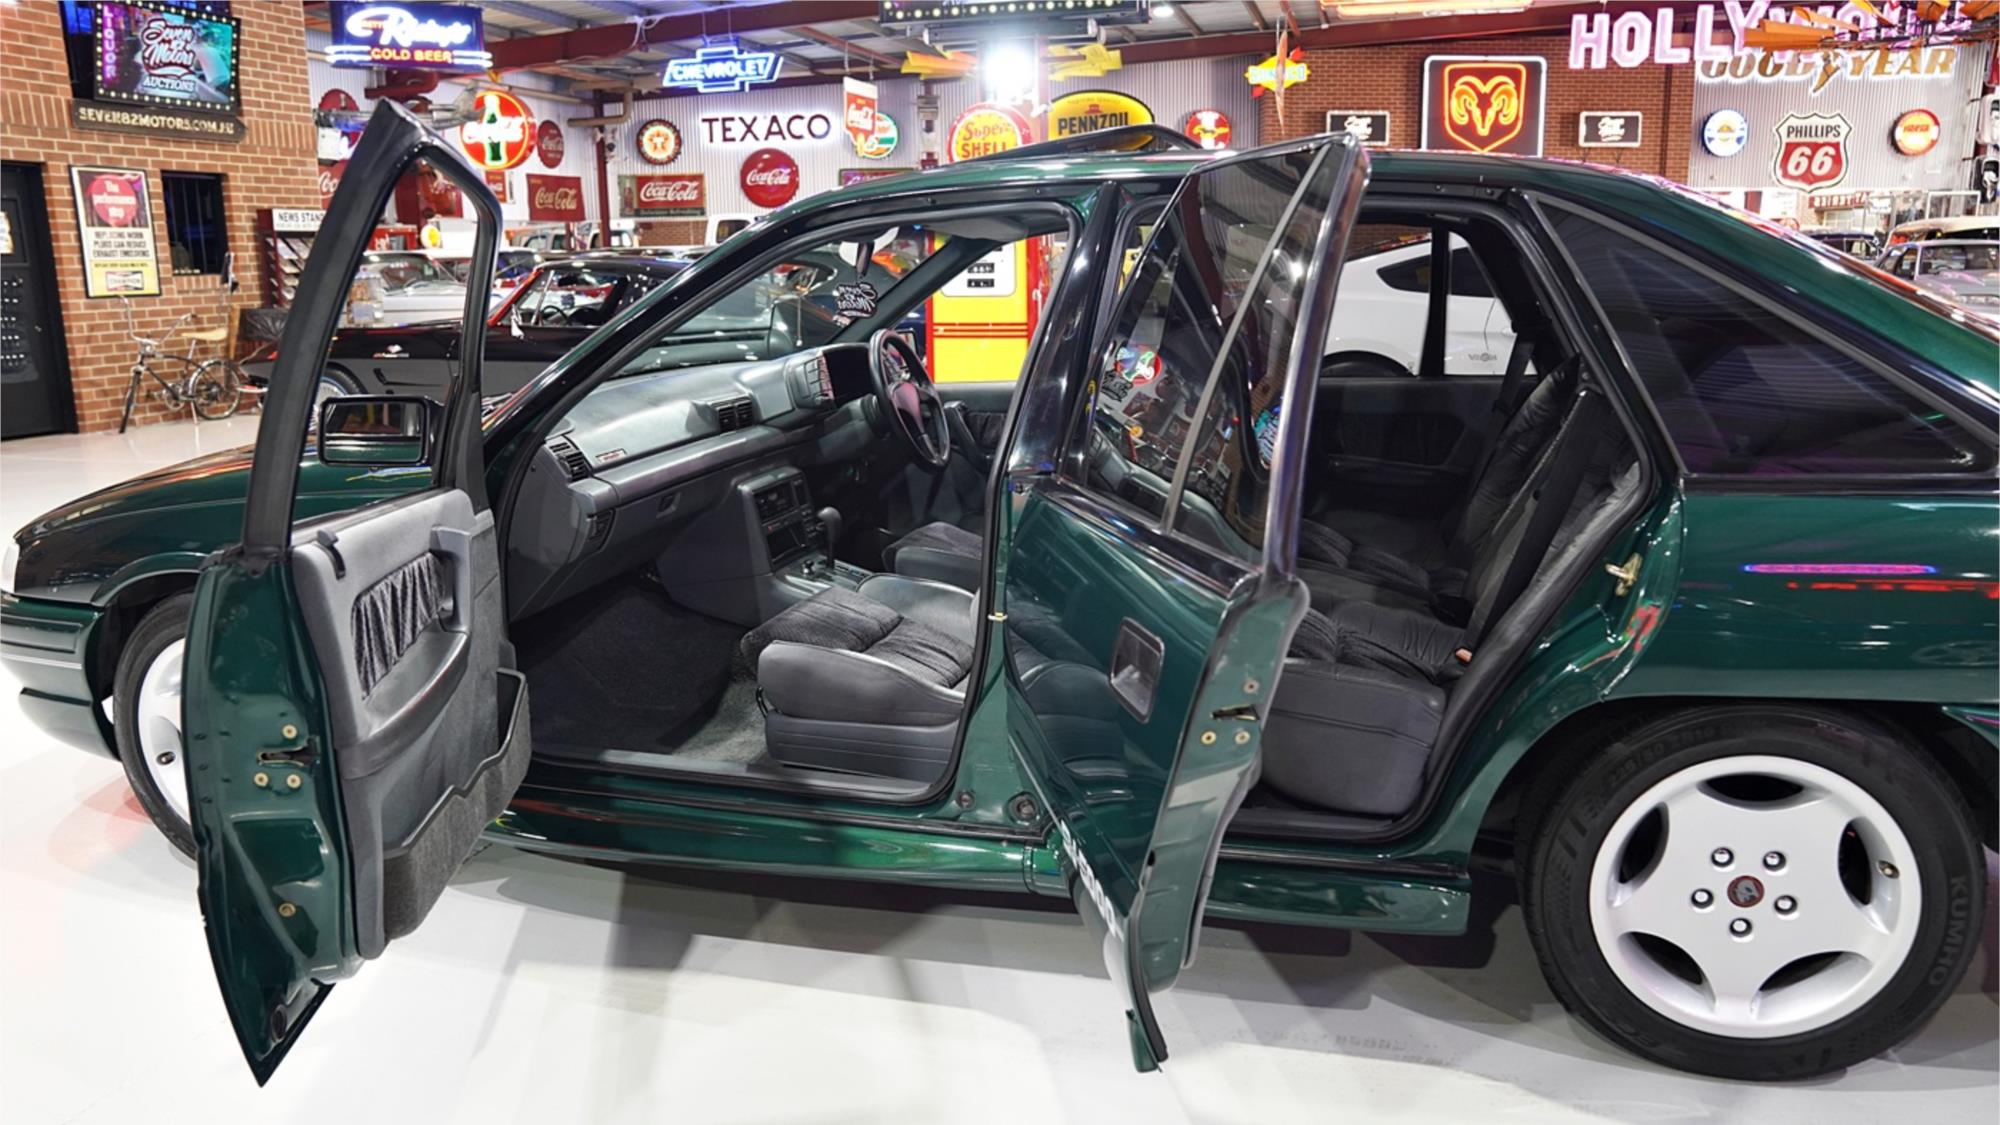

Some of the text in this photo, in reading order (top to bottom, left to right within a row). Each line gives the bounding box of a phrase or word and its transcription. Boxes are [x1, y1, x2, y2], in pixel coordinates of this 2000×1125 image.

[103, 5, 118, 79] LIQUOR
[371, 48, 452, 63] COLD BEER
[673, 57, 768, 81] CHEVROLET
[143, 78, 195, 92] AUCTIONS
[702, 114, 831, 143] TEXACO
[1787, 125, 1841, 138] PHILLIPS
[1787, 146, 1836, 176] 66
[279, 212, 299, 222] NEWS
[1928, 875, 1969, 986] KUMHO
